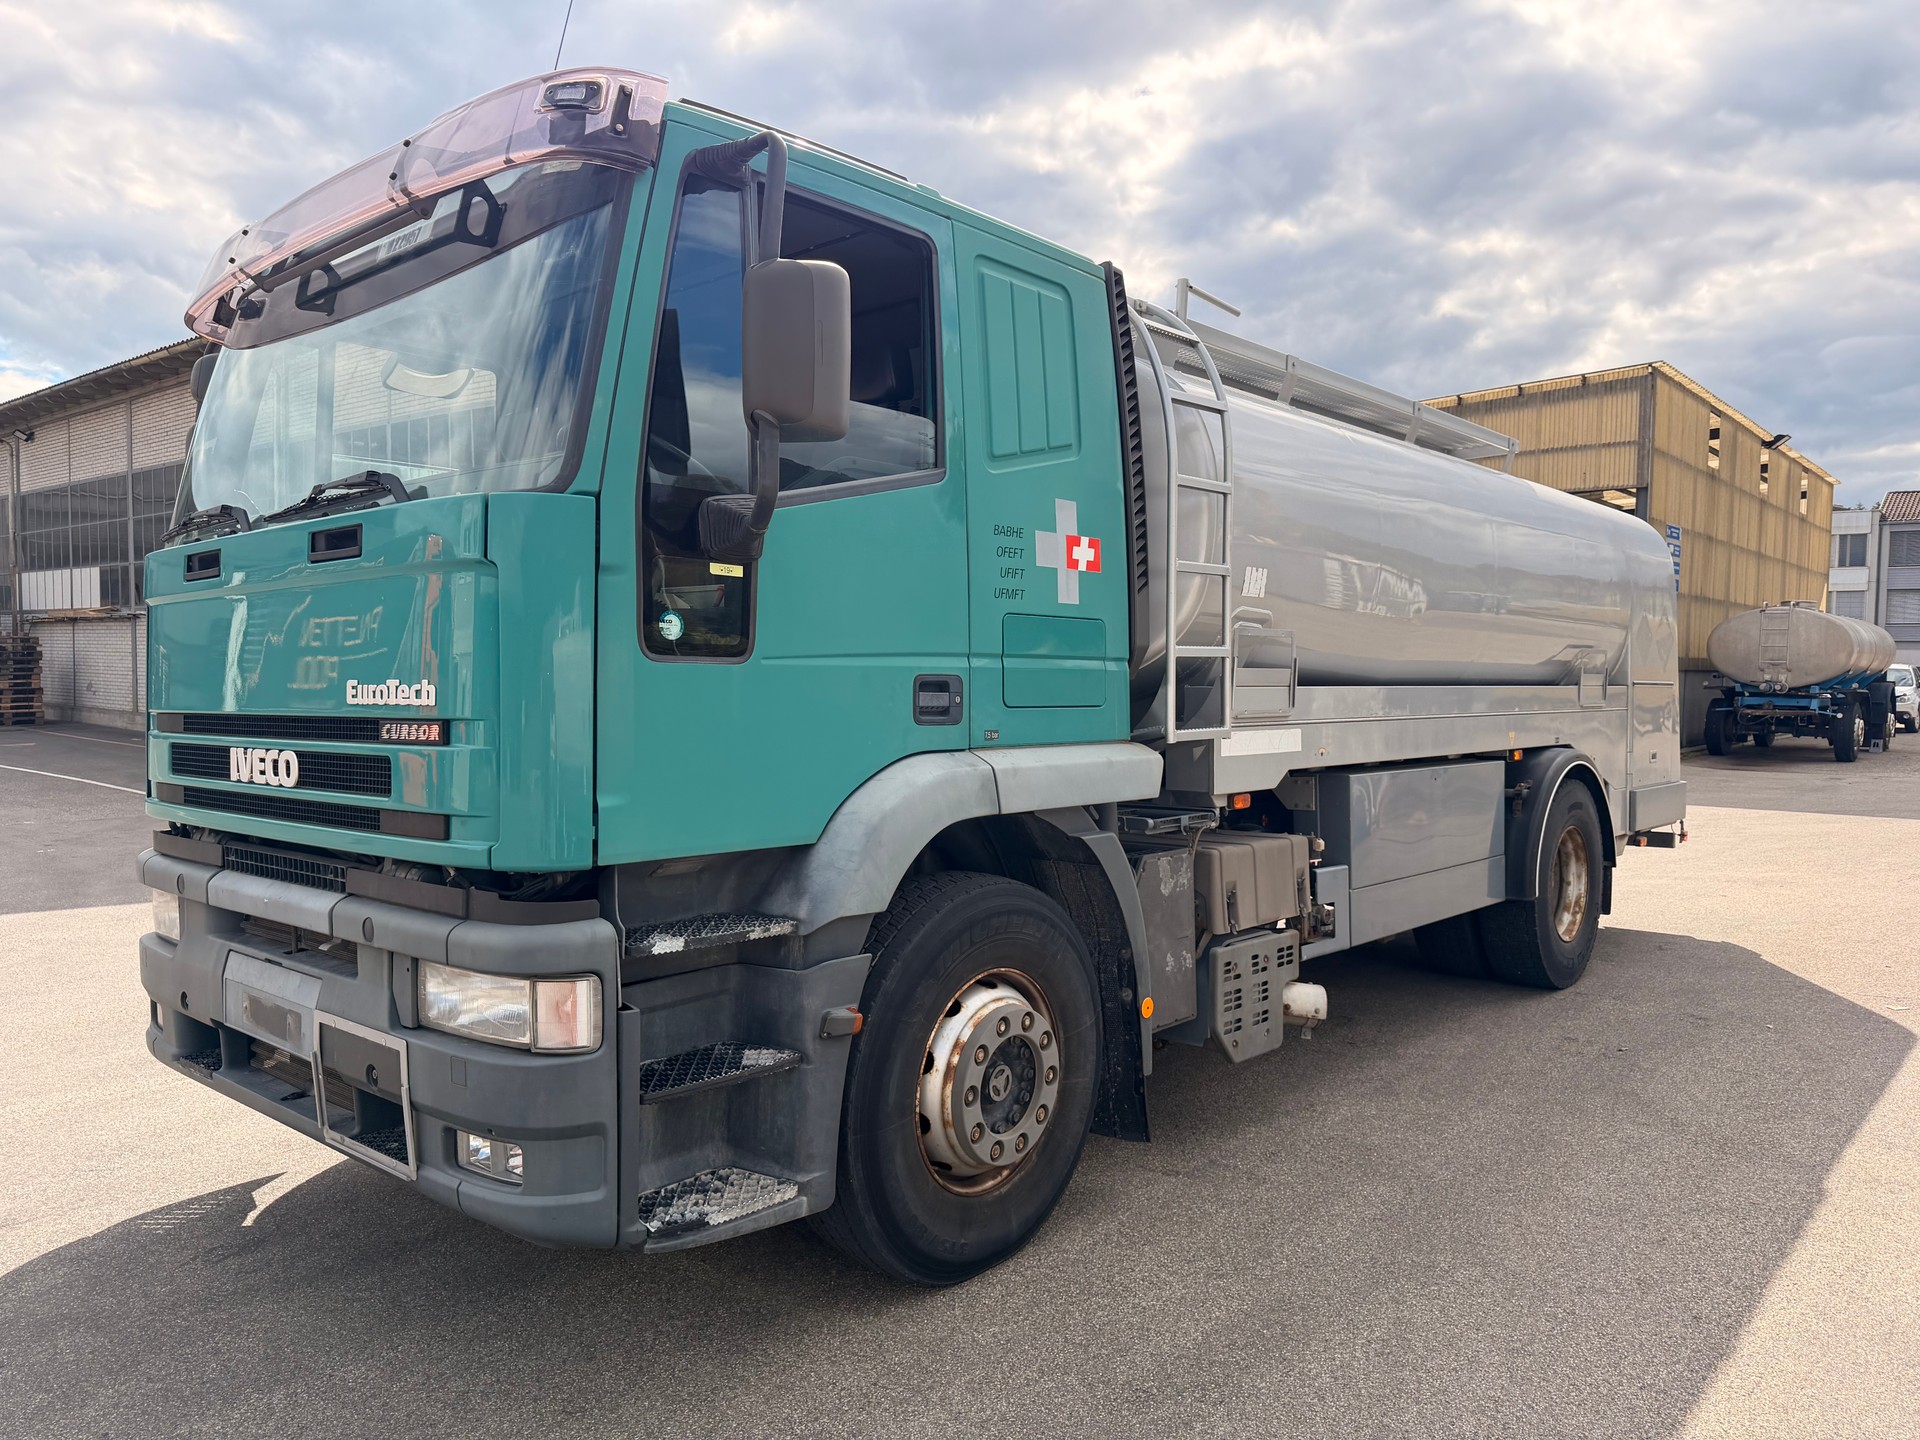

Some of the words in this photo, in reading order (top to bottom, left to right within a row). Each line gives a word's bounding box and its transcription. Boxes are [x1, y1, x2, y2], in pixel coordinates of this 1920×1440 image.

[993, 524, 1025, 539] BABHE
[996, 545, 1025, 560] OFEFT
[999, 566, 1026, 580] UFIFT
[993, 587, 1026, 601] UFMFT
[346, 679, 436, 706] EuroTech
[380, 723, 440, 741] CURSOR
[229, 746, 299, 788] IVECO
